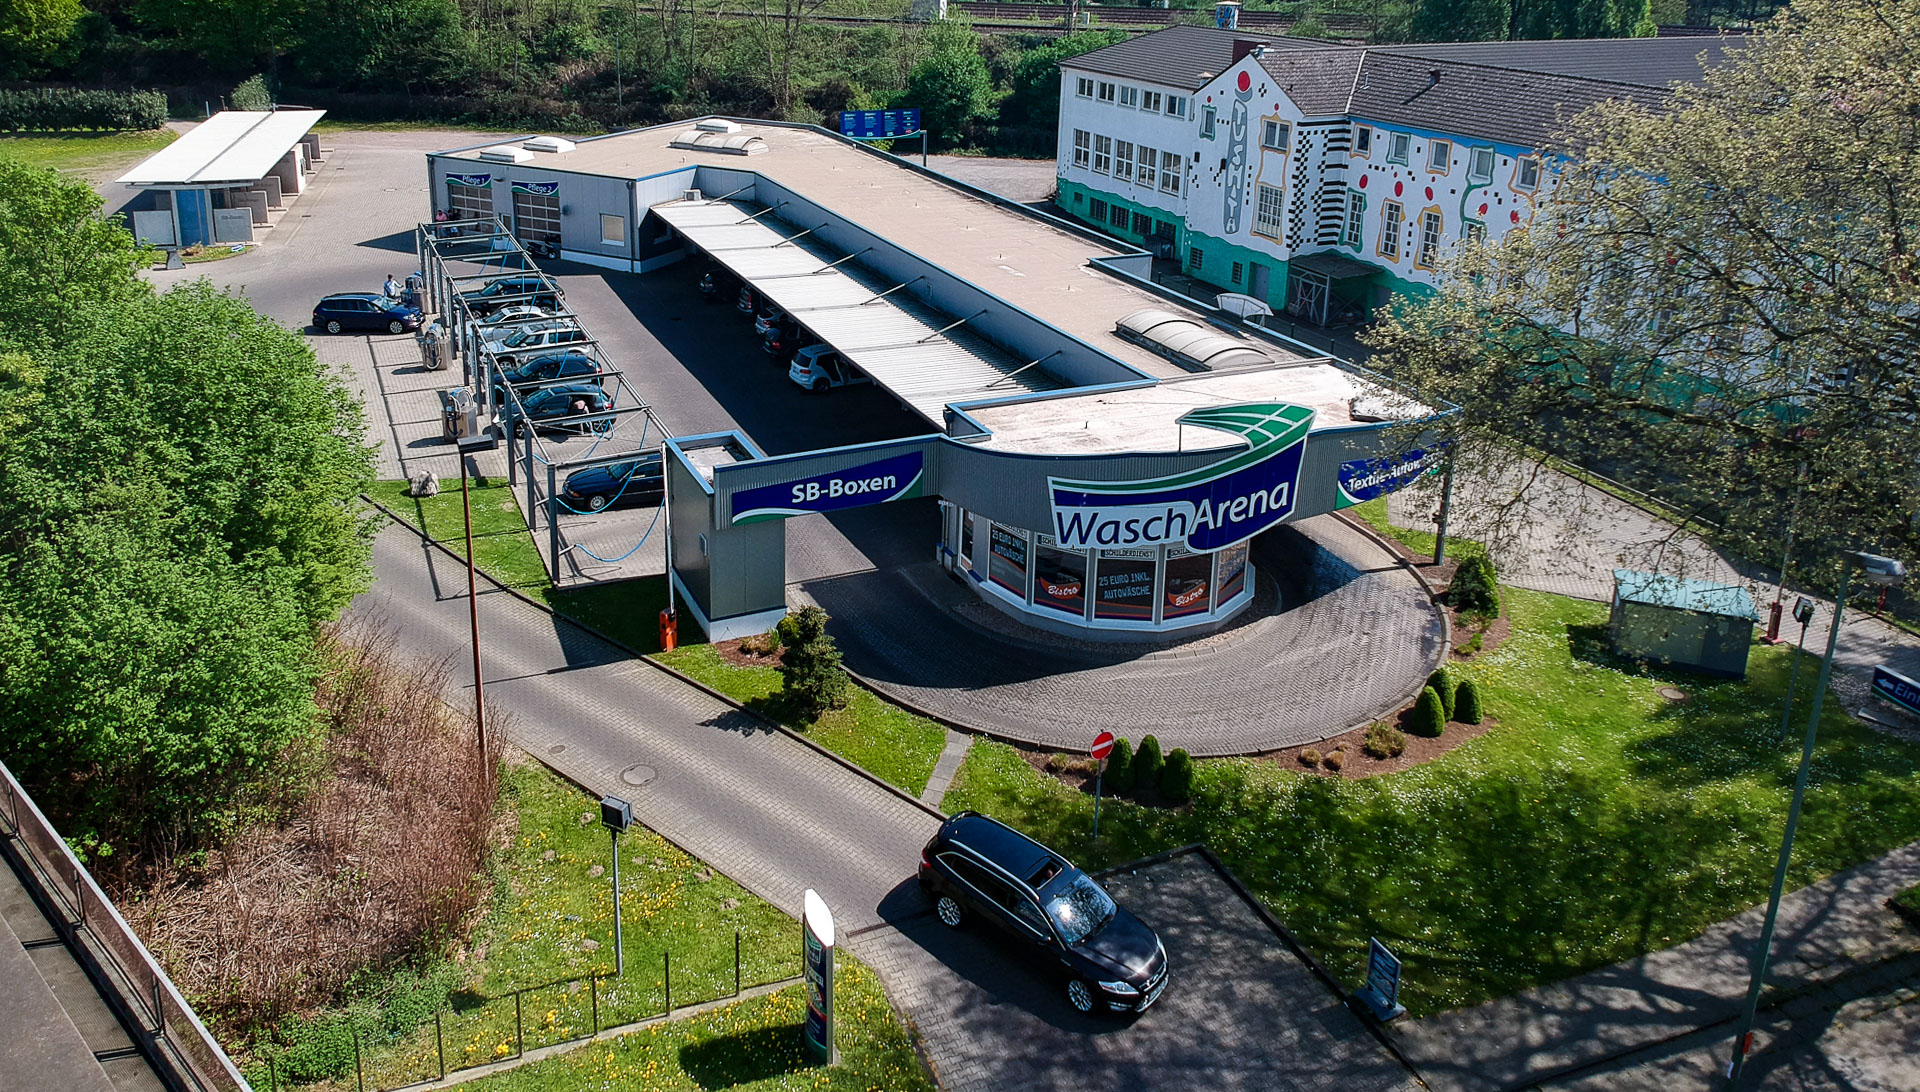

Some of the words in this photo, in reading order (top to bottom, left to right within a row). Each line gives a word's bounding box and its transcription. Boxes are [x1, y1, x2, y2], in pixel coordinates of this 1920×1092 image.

[462, 175, 481, 186] Pflege
[527, 183, 546, 194] Pflege
[791, 475, 896, 504] SB-Boxen
[1105, 548, 1153, 559] SCHILDERDIENST
[1098, 576, 1109, 587] 25
[1110, 574, 1129, 585] EURO
[1047, 585, 1079, 596] Bistro
[1103, 585, 1151, 600] AUTOWÄSCHE
[1175, 587, 1204, 606] Bistro
